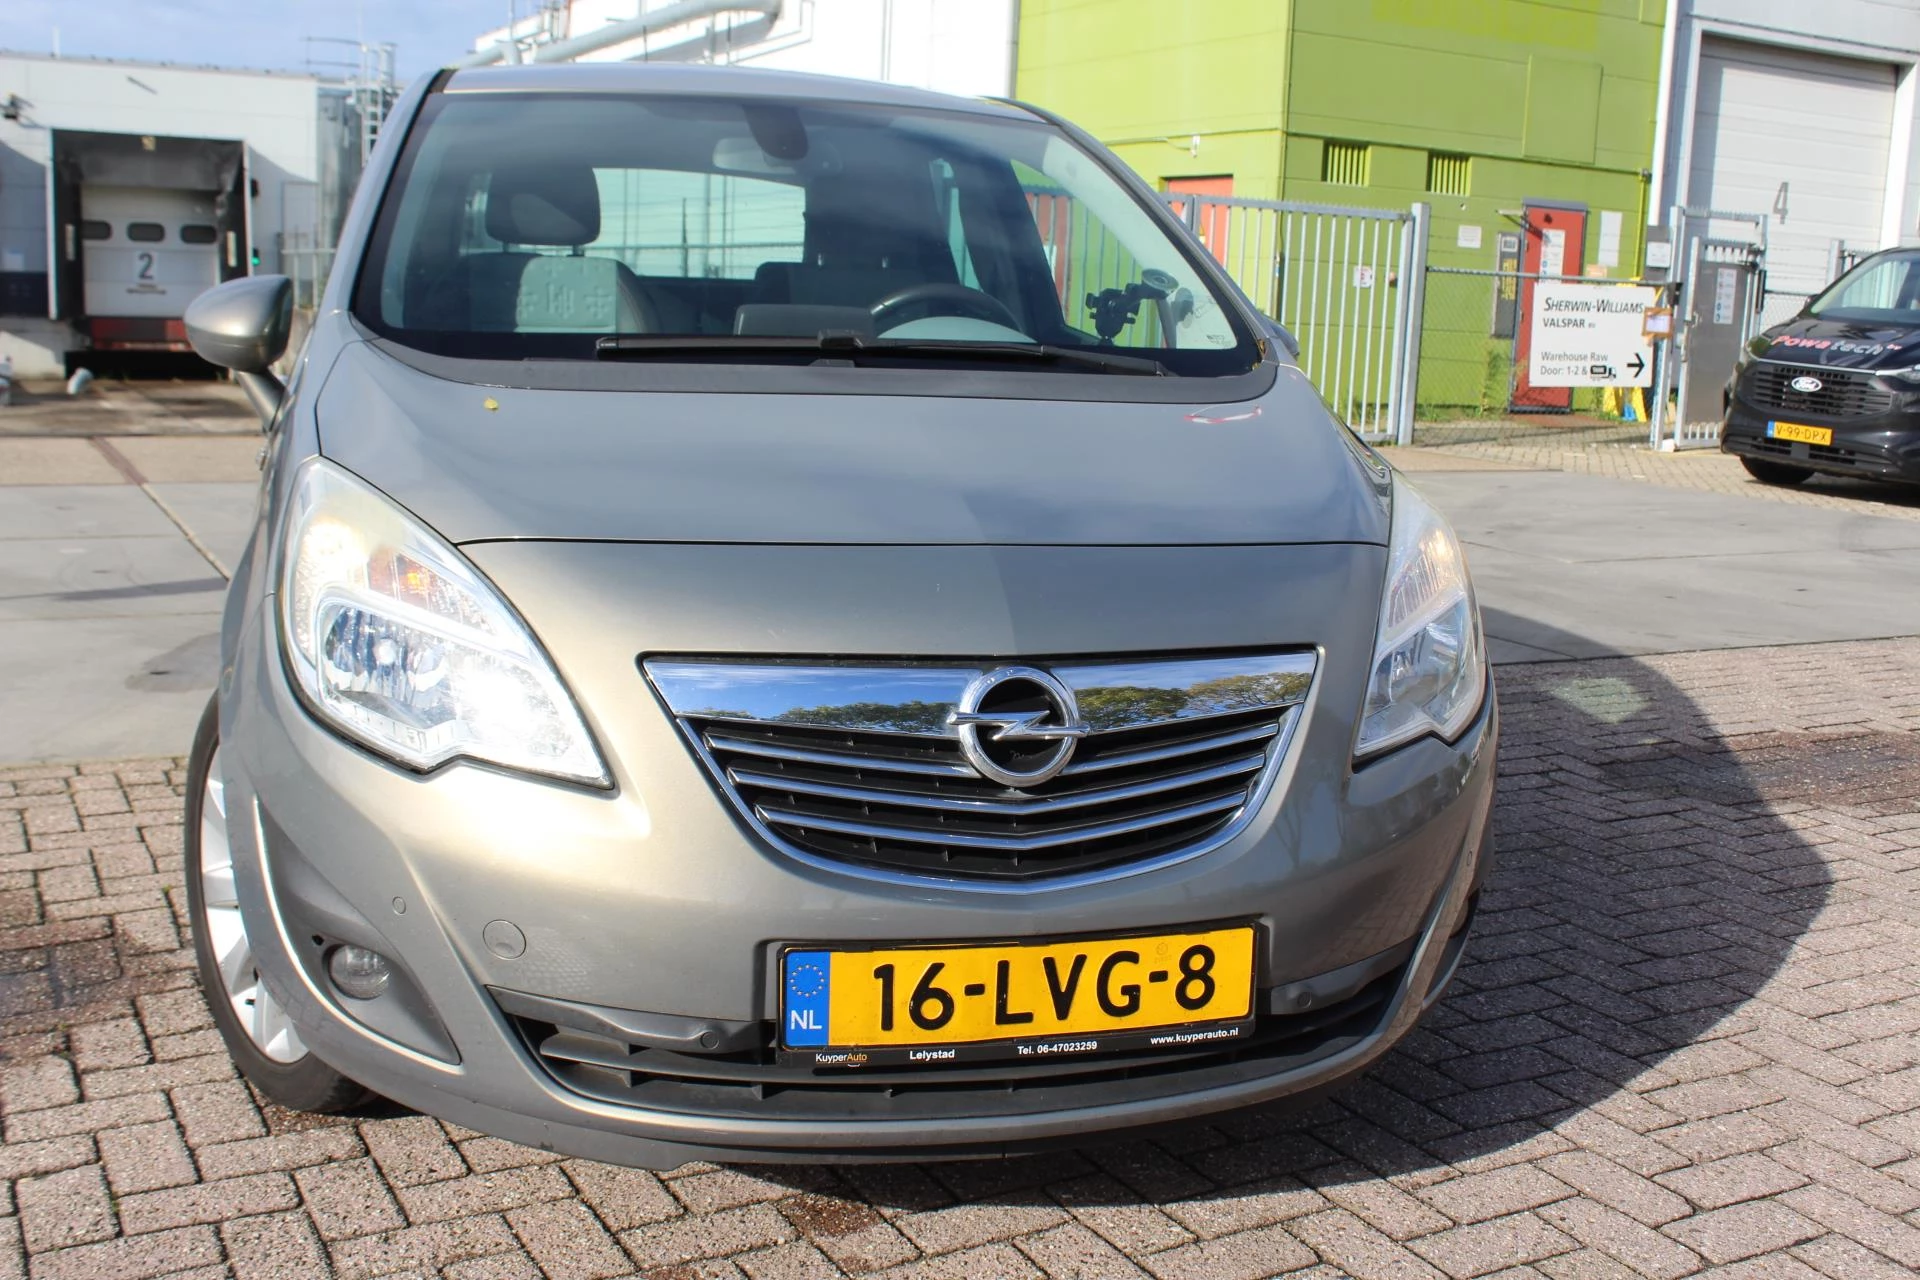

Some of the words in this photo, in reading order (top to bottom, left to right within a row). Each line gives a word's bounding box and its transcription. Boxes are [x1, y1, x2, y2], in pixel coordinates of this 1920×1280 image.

[1772, 182, 1789, 224] 4
[138, 252, 154, 280] 2
[1542, 317, 1585, 328] VALSPAR
[1541, 351, 1588, 361] Warehouse
[1590, 352, 1608, 361] Raw
[1540, 365, 1564, 376] Door:
[1567, 366, 1580, 376] 1-2
[1581, 366, 1588, 376] &
[1775, 424, 1827, 442] V-99-DPX
[873, 944, 1216, 1032] 16-LVG-8
[790, 1008, 822, 1031] NL
[815, 1053, 868, 1064] KuyperAuto
[909, 1049, 955, 1061] Lelystad
[1017, 1045, 1034, 1055] Tel.
[1036, 1040, 1098, 1054] 06-47023259
[1150, 1027, 1239, 1045] www.kuyperauto.nl
